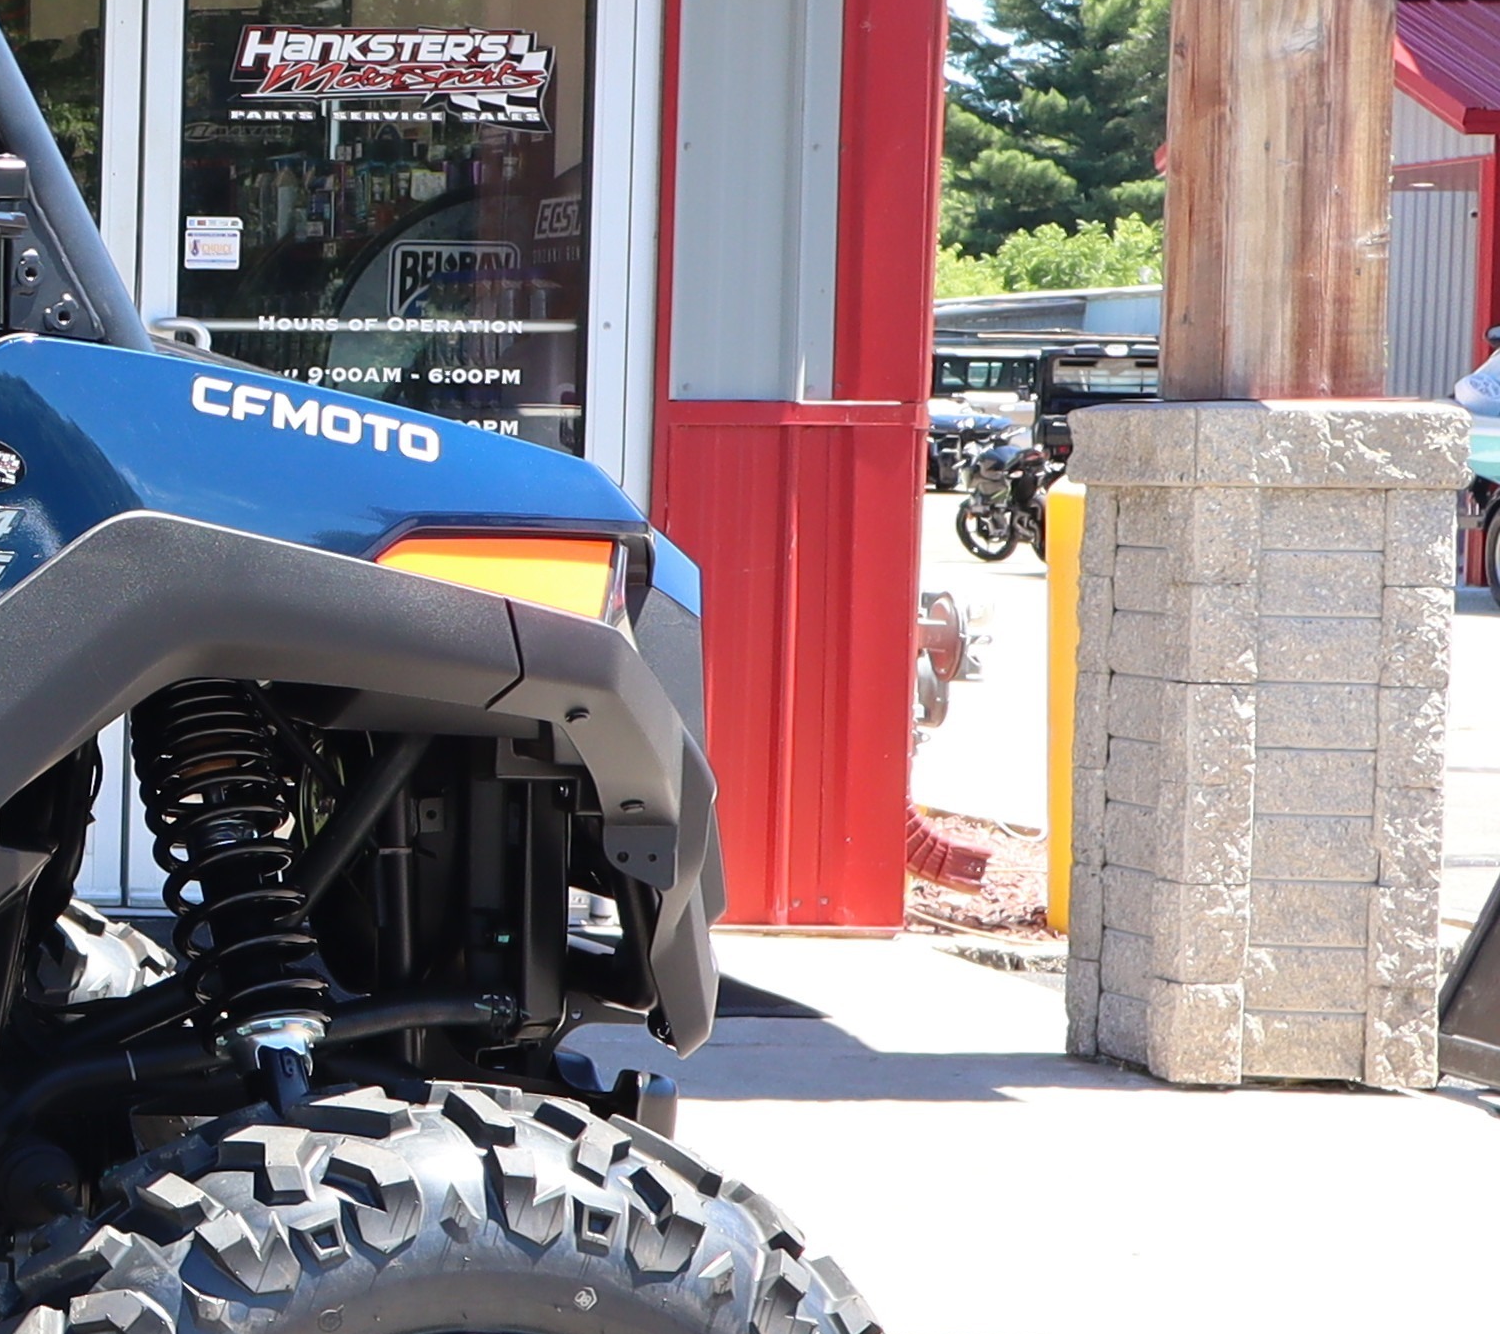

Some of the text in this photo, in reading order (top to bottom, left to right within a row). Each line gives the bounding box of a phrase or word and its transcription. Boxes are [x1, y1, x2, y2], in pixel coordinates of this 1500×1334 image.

[230, 110, 541, 122] PARTS SERVICE SALES
[428, 368, 521, 385] 6:00PM
[191, 376, 441, 463] CFMOTO
